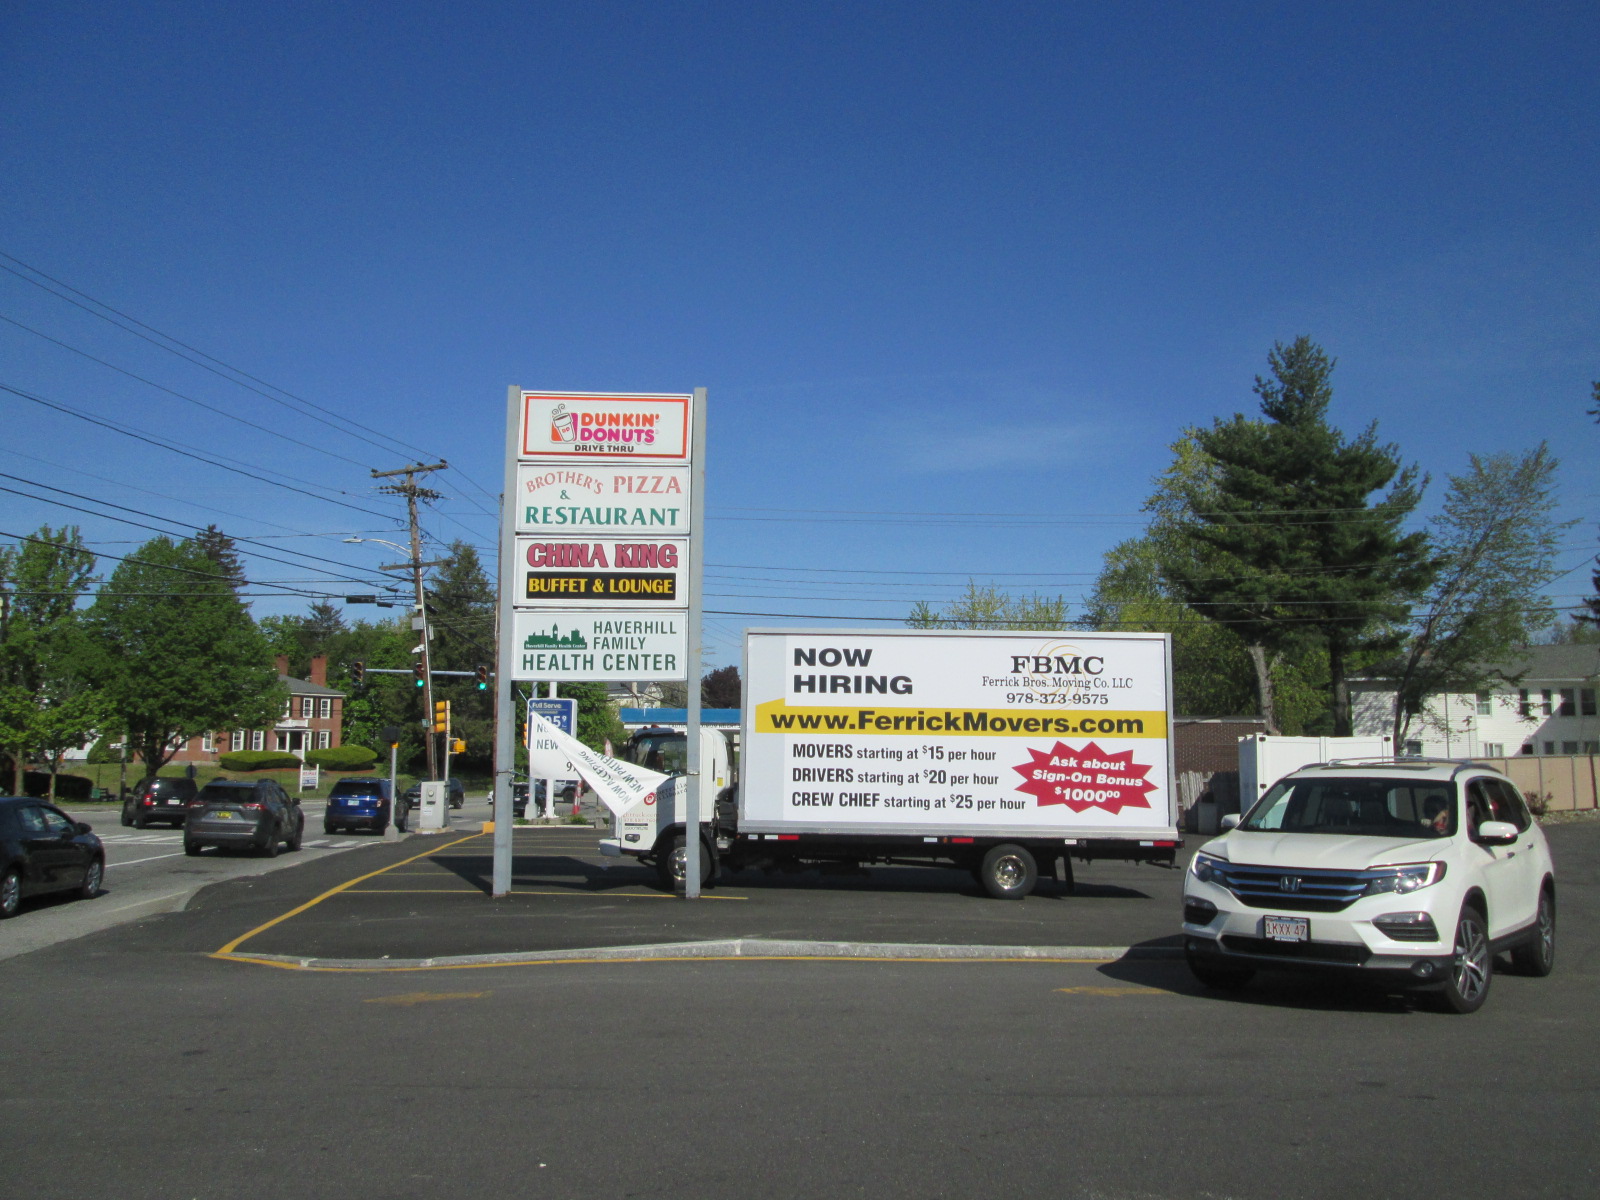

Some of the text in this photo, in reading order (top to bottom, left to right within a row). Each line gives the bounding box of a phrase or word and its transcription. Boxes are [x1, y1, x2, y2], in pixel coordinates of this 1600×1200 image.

[581, 412, 660, 428] DUNKIN'
[580, 427, 655, 443] DONUTS
[574, 444, 634, 453] DRIVE THRU
[526, 471, 682, 494] BROTHER'S PIZZA
[560, 489, 571, 500] &
[525, 506, 680, 526] RESTAURANT
[526, 543, 678, 568] CHINA KING
[528, 578, 673, 594] BUFFET & LOUNGE
[593, 621, 677, 635] HAVERHILL
[593, 637, 646, 650] FAMILY
[522, 654, 676, 671] HEALTH CENTER
[793, 648, 873, 667] NOW
[1010, 656, 1104, 675] FBMC
[793, 675, 913, 694] HIRING
[982, 676, 1133, 691] Ferrick Bros. Moving Co. LLC
[1006, 693, 1108, 705] 978-373-9575
[770, 711, 1144, 734] www.FerrickMovers.com
[536, 739, 559, 750] NEW
[792, 744, 997, 763] MOVERS starting at $15 per hour
[1049, 756, 1126, 771] Ask about
[578, 751, 632, 805] NOW ACCEPTING
[622, 774, 644, 793] NEW
[792, 768, 999, 787] DRIVERS starting at $20 per hour
[1032, 769, 1143, 787] Sign-On Bonus
[792, 792, 1026, 812] CREW CHIEF starting at $25 per hour
[1266, 922, 1306, 936] 1KXX 47
